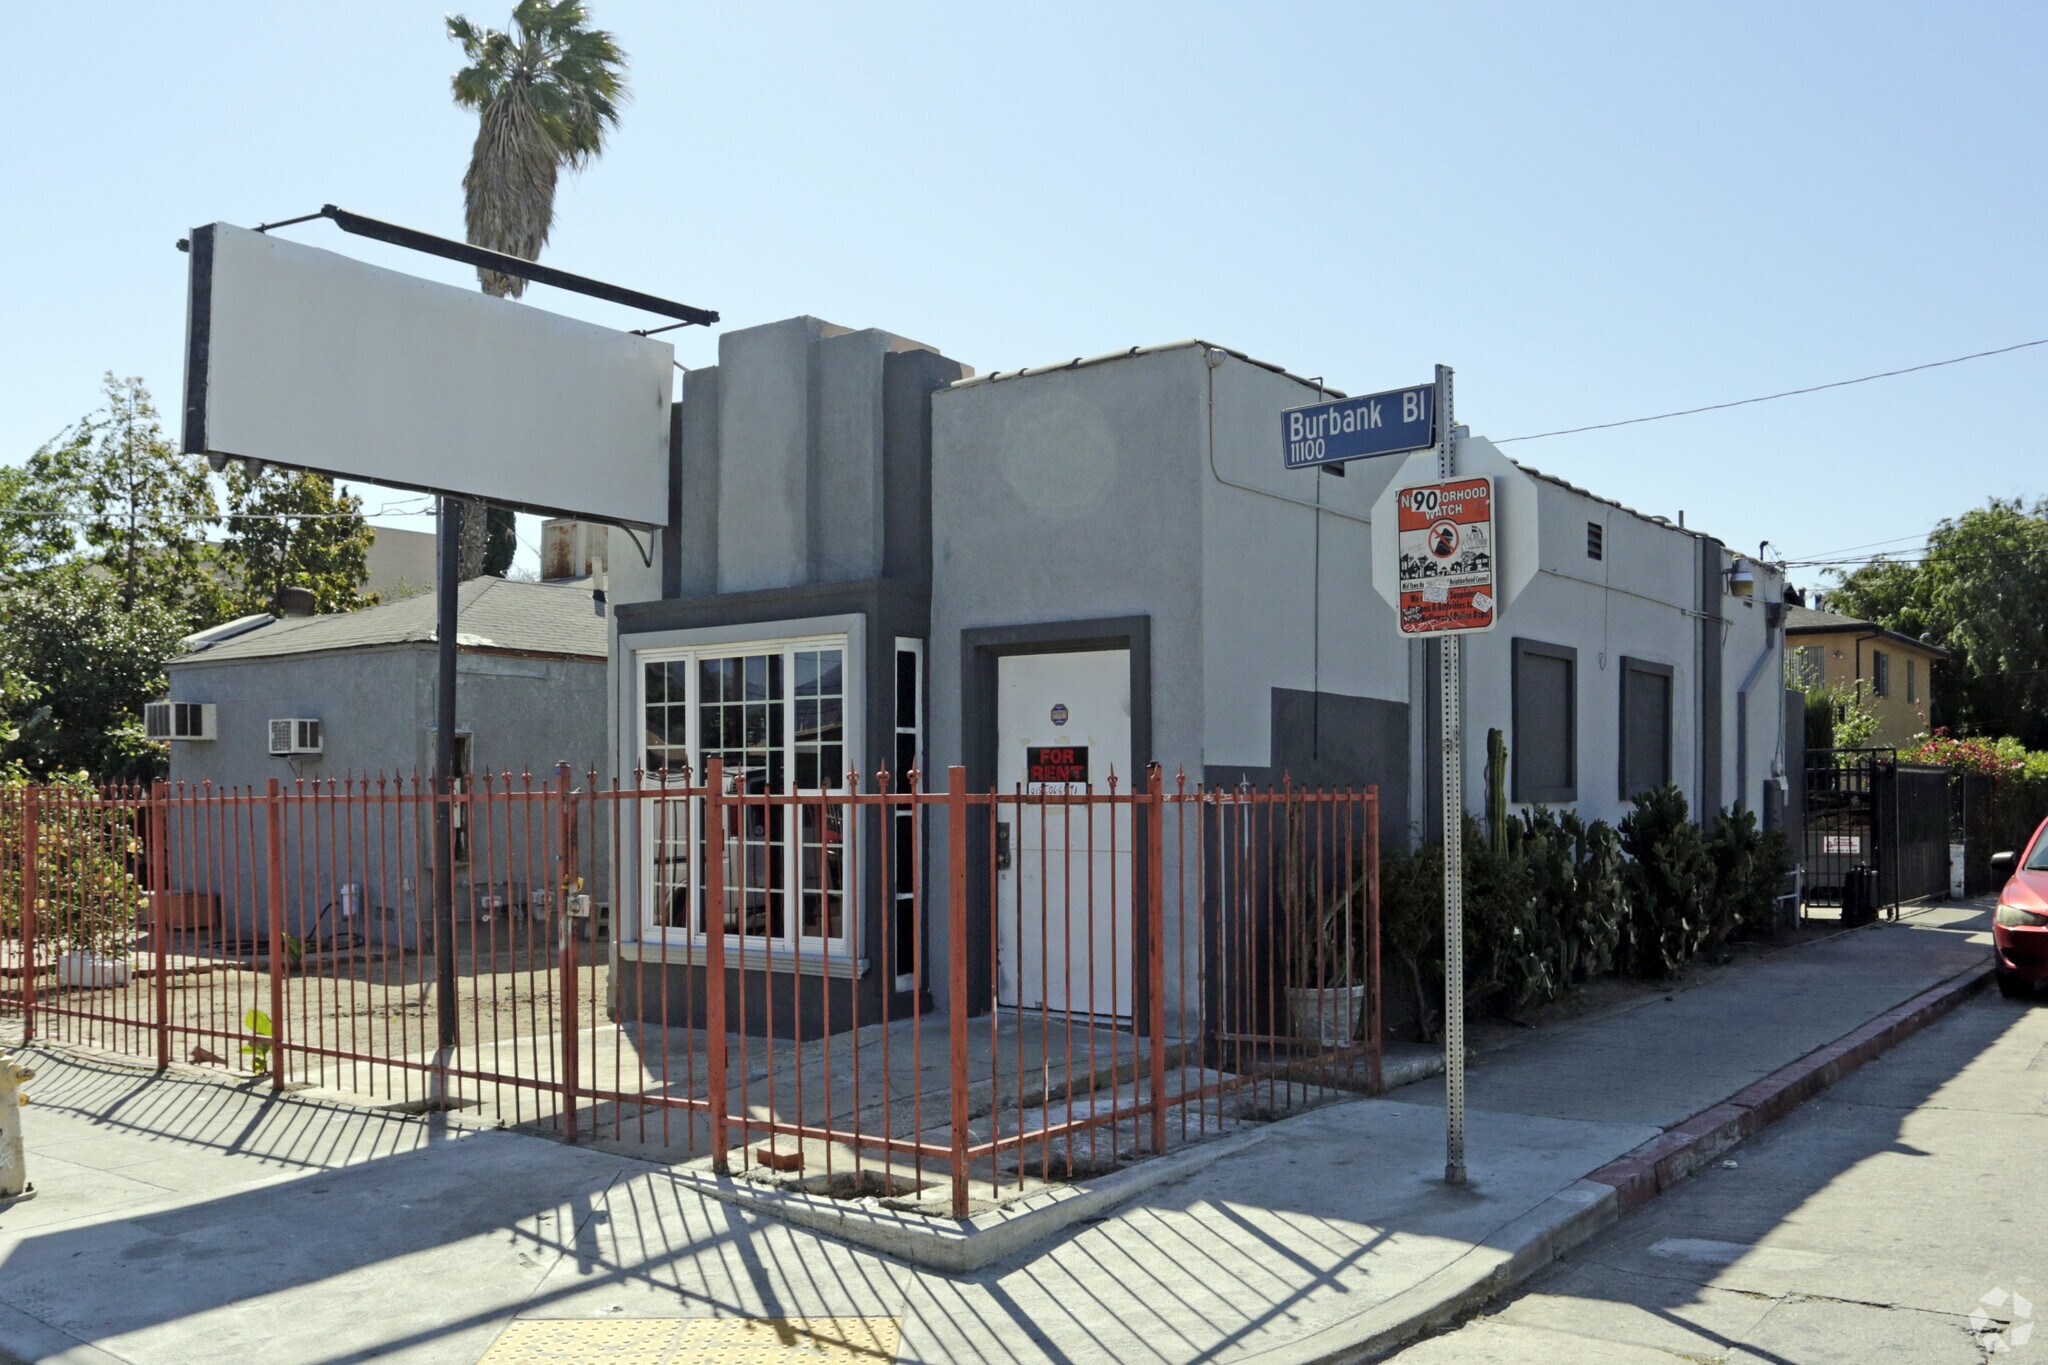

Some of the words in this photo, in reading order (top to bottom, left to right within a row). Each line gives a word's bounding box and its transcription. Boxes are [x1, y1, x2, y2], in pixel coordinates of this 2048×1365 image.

[1290, 400, 1382, 442] Burbank
[1403, 390, 1425, 423] Bl
[1291, 438, 1325, 463] 11100
[1413, 491, 1438, 511] 90
[1040, 748, 1074, 764] FOR
[1031, 765, 1084, 782] RENT
